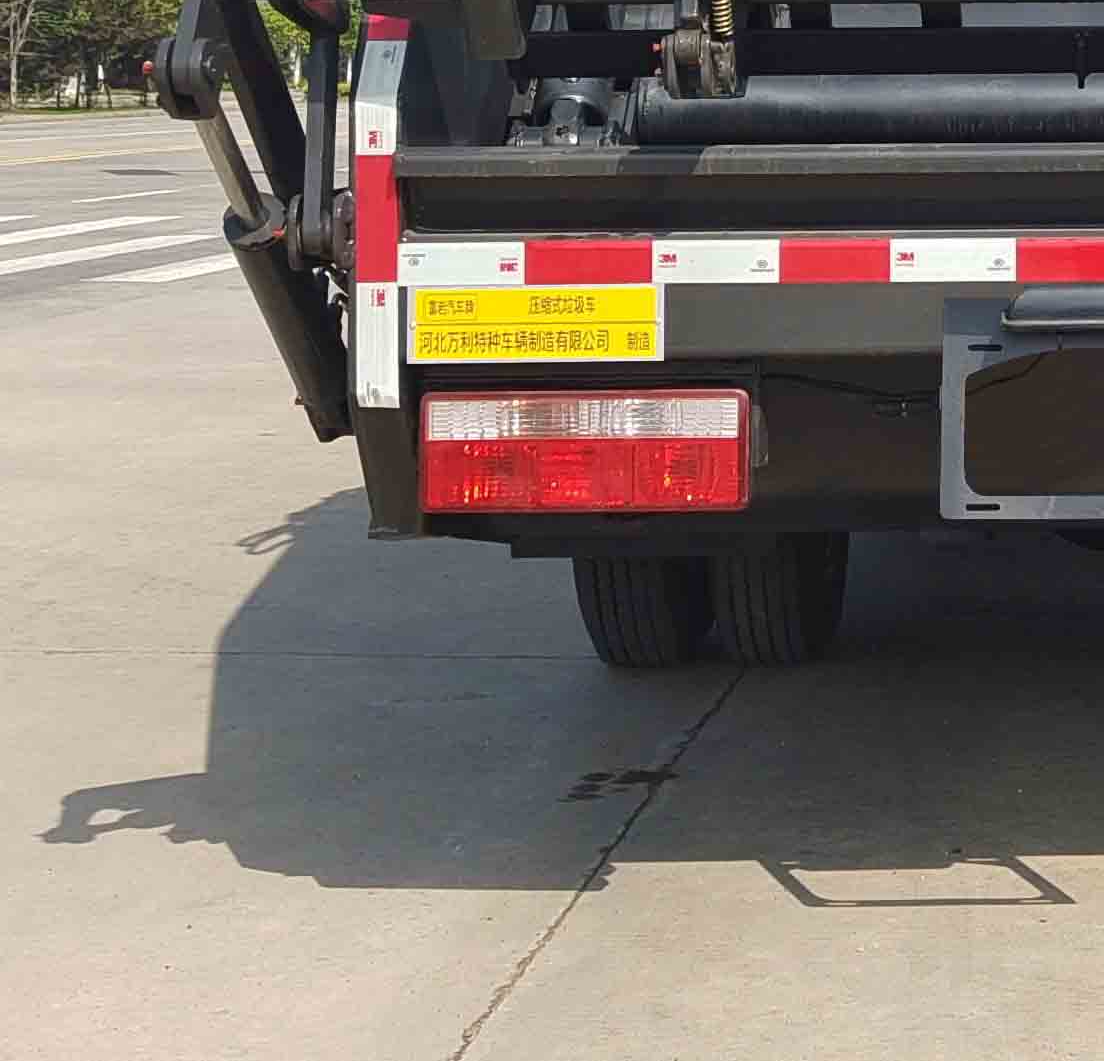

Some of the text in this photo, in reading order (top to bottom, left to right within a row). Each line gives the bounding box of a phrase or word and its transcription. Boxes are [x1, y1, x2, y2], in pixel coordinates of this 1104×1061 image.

[368, 131, 379, 148] 3M
[659, 253, 677, 263] 3M
[896, 251, 914, 262] 3M
[376, 288, 386, 307] 3M
[528, 295, 596, 316] 压缩式垃圾车
[626, 331, 651, 352] 制造
